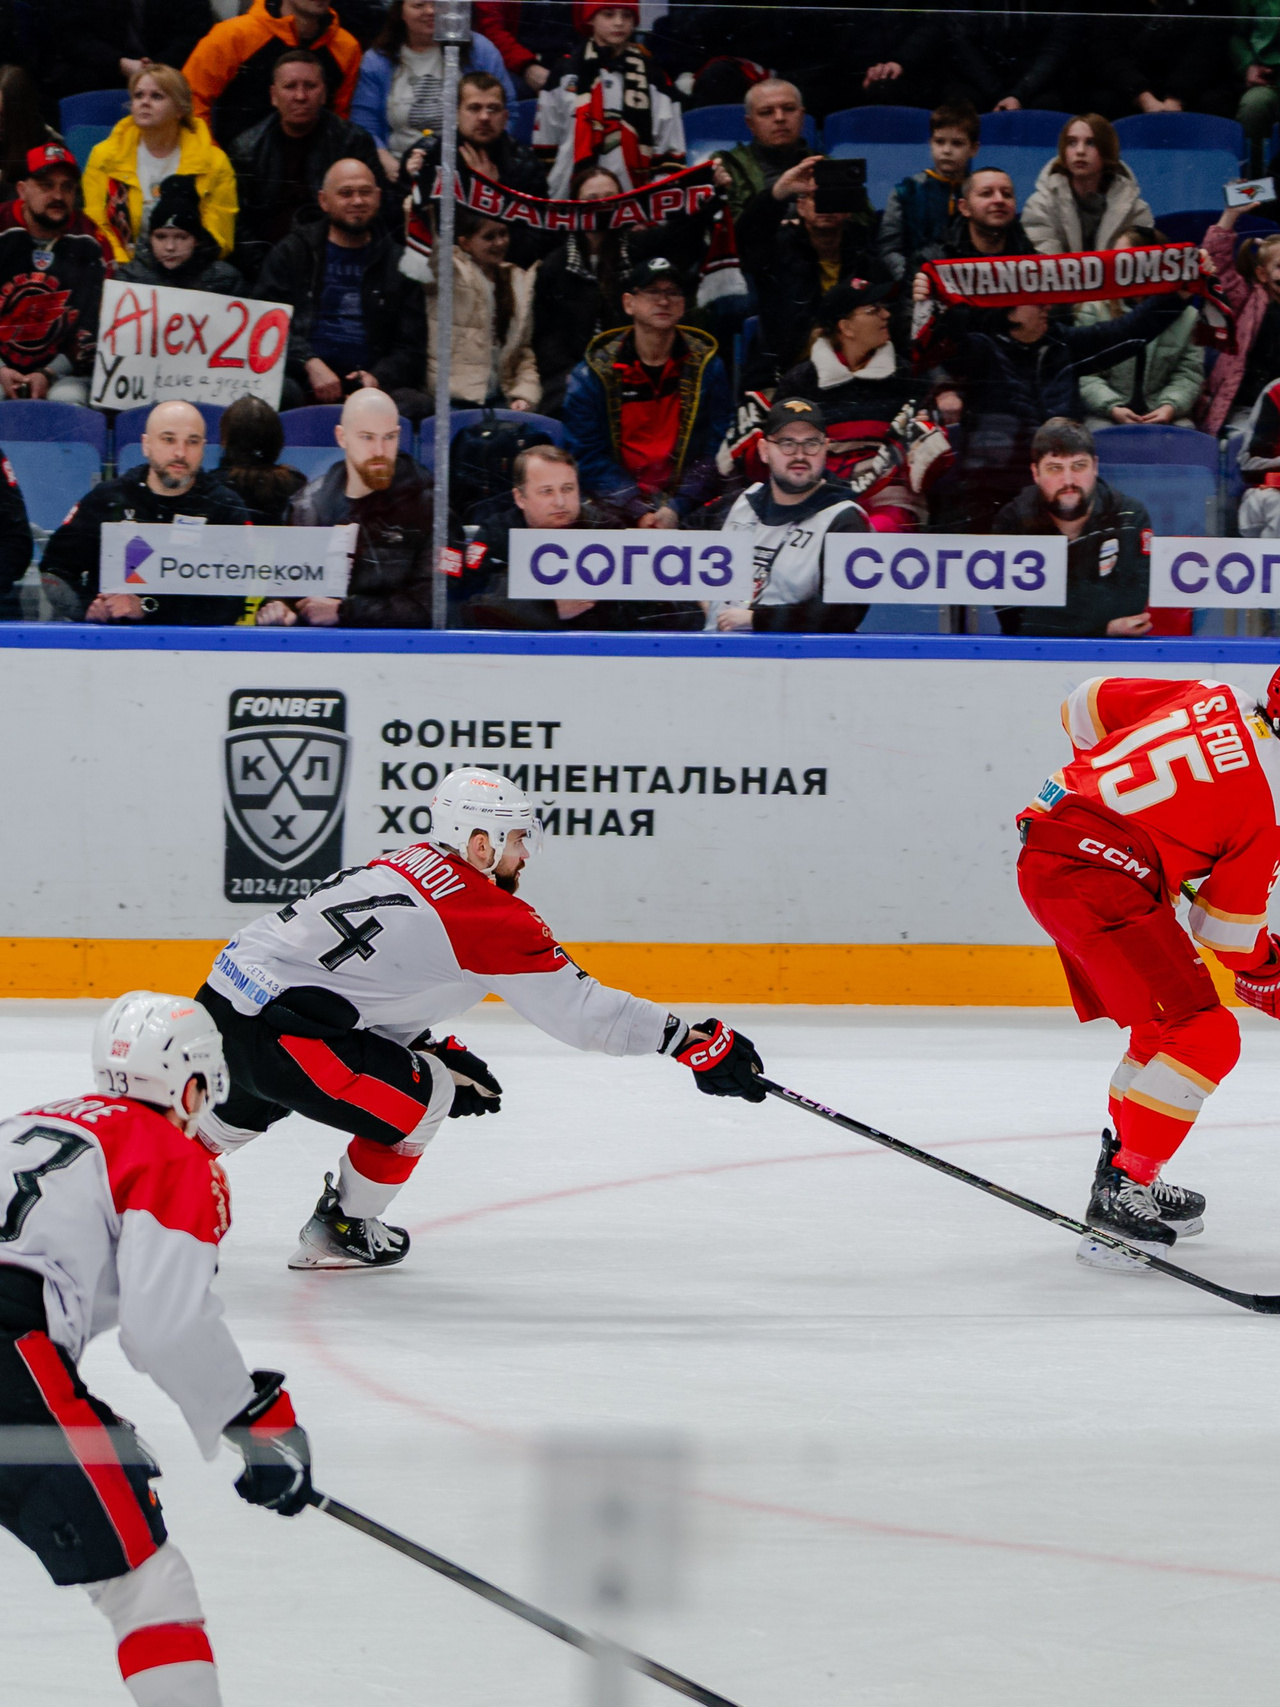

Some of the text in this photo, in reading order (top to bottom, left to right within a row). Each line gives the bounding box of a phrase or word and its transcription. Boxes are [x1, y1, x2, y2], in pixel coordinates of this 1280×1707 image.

[89, 351, 147, 403] You
[790, 528, 814, 549] 27
[160, 557, 324, 582] Ростелеком
[529, 543, 734, 587] согаз
[844, 546, 1047, 591] согаз
[234, 696, 340, 718] FONBET
[381, 718, 561, 749] ФОНБЕТ
[1200, 722, 1250, 774] FOO
[241, 755, 330, 781] К Л
[1091, 708, 1215, 816] 15
[378, 801, 655, 837] ХОЙНАЯ
[1078, 838, 1151, 879] CCM
[106, 1069, 129, 1094] 13
[782, 1088, 838, 1118] CCM
